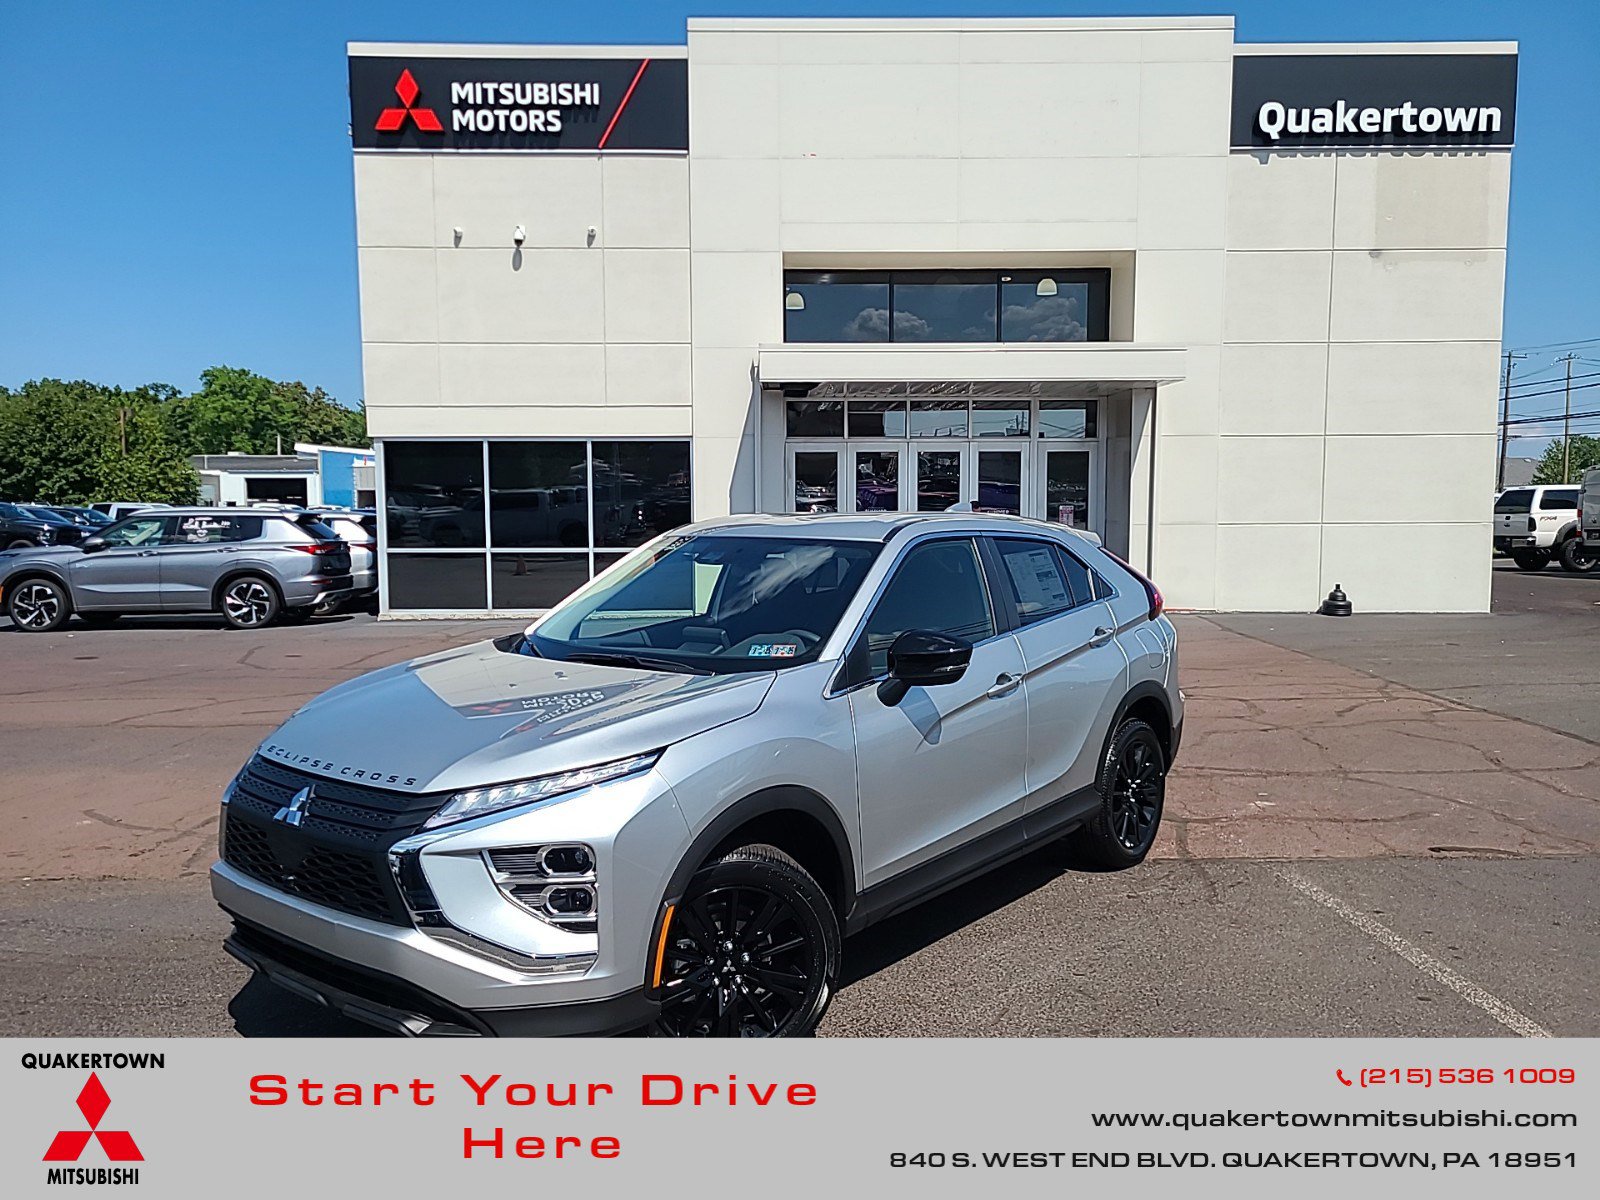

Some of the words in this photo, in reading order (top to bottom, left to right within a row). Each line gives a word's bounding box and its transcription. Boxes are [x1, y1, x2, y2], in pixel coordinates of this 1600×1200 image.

[450, 81, 600, 106] MITSUBISHI
[452, 108, 562, 133] MOTORS
[1258, 100, 1502, 140] Quakertown
[266, 744, 335, 771] ECLIPSE
[340, 766, 417, 786] CROSS
